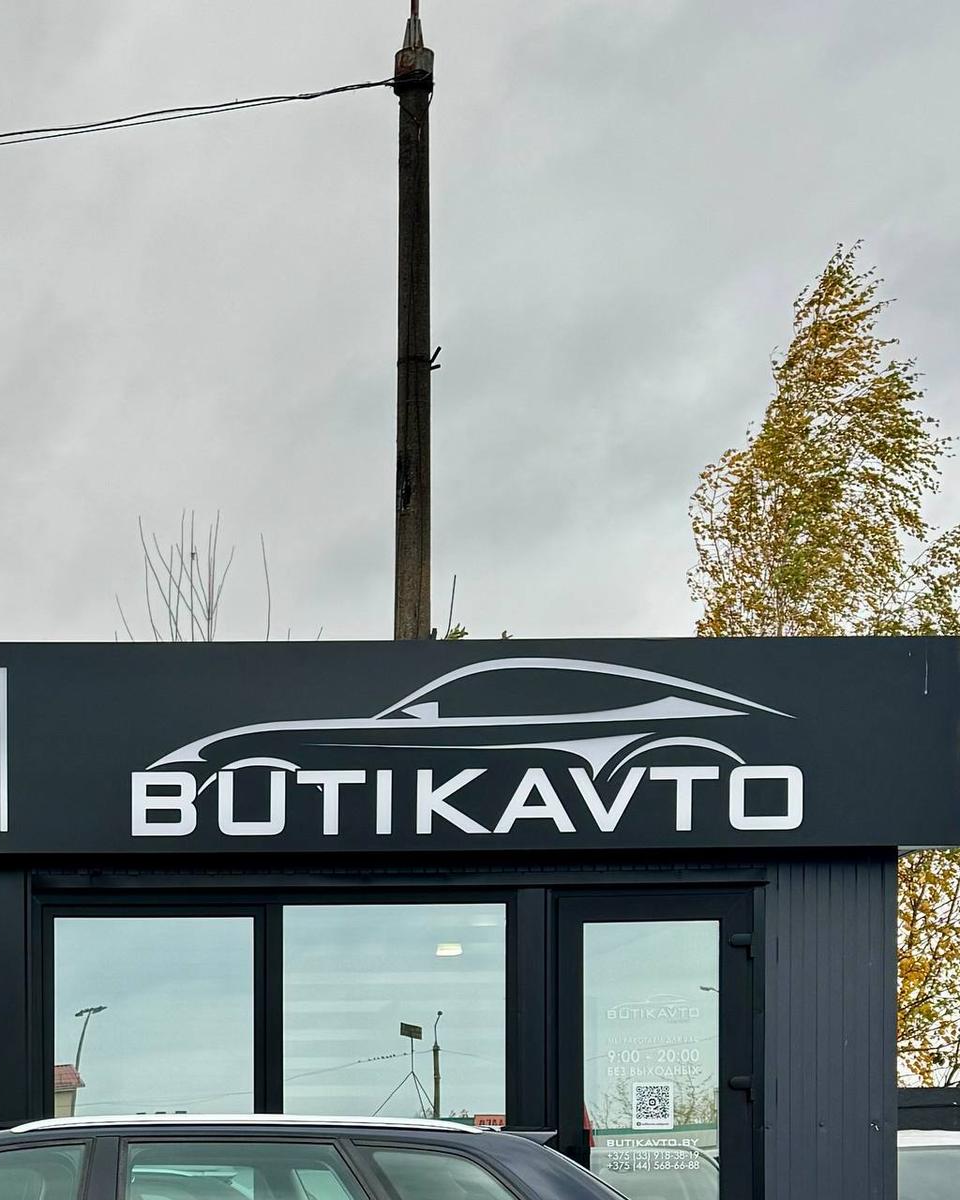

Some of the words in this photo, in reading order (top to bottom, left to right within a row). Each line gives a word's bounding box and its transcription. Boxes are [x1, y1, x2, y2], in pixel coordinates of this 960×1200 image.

[131, 764, 804, 836] BUTIKAVTO
[607, 1007, 699, 1019] BUTIKAVTO
[607, 1049, 640, 1063] 9:00
[657, 1048, 700, 1062] 20:00
[607, 1066, 626, 1076] БЕЗ
[630, 1065, 699, 1077] ВЫХОДНЫХ
[606, 1138, 699, 1147] BUTIKAVTO.BY
[607, 1151, 630, 1160] +375
[632, 1150, 651, 1161] (33)
[653, 1150, 700, 1160] 918-38-19
[607, 1161, 630, 1170] +375
[632, 1160, 651, 1171] (44)
[653, 1160, 700, 1170] 568-66-88
